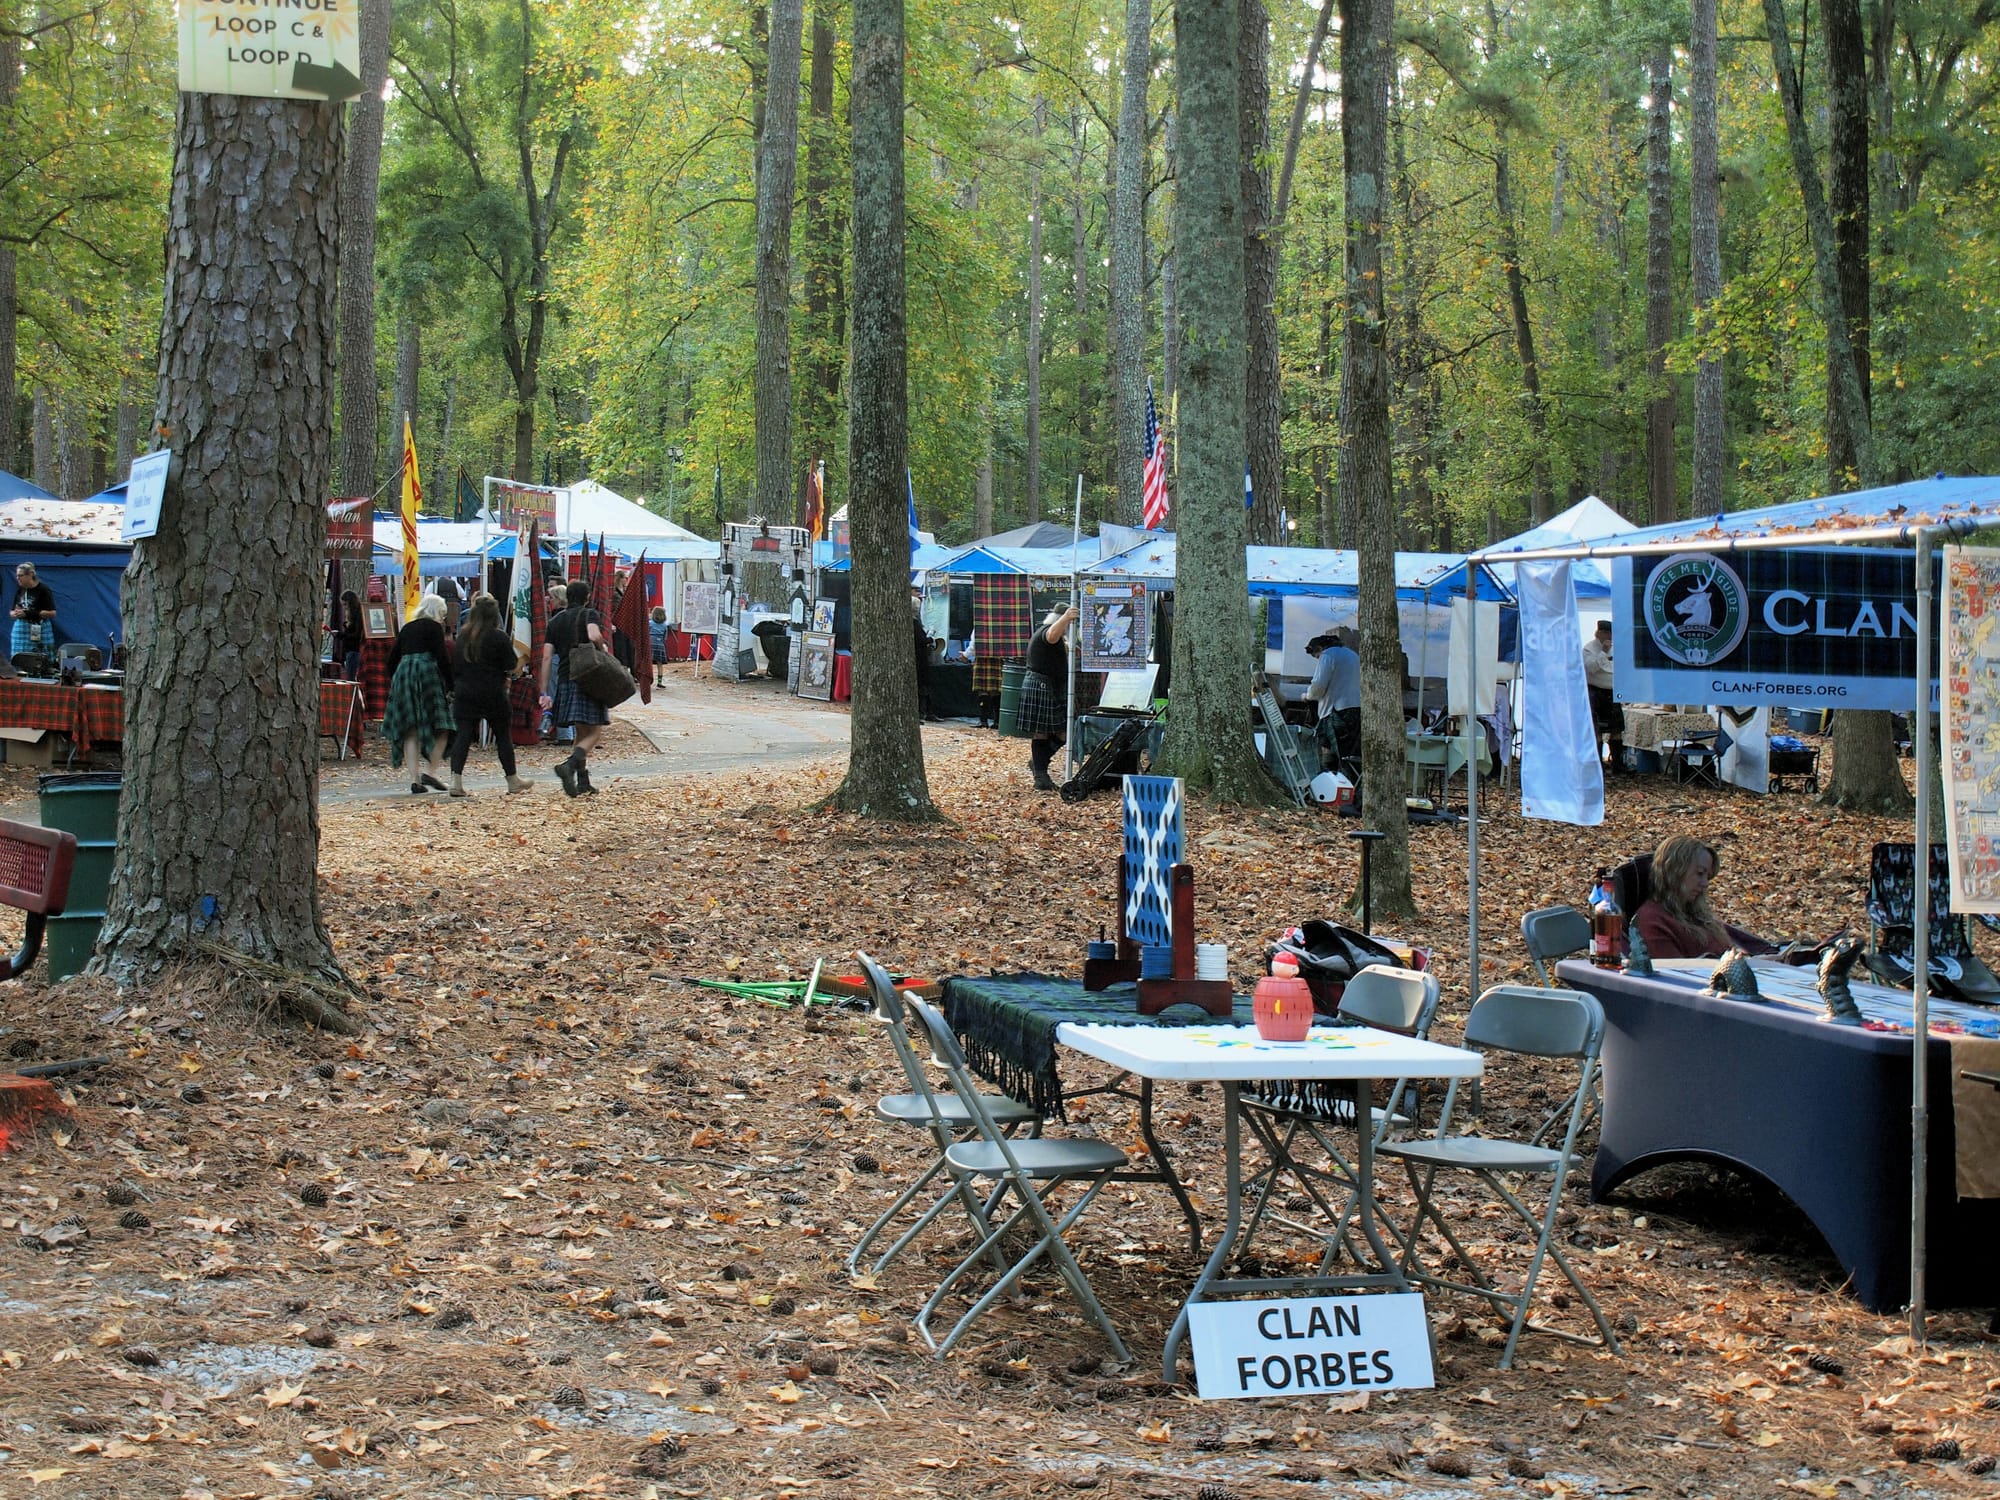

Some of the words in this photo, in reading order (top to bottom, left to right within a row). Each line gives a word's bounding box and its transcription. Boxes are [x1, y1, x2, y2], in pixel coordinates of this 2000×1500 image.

[215, 16, 277, 34] LOOP
[291, 22, 304, 36] C
[312, 26, 323, 38] &
[228, 47, 289, 65] LOOP
[1653, 570, 1677, 612] GRACE
[1681, 563, 1698, 574] ME
[1718, 575, 1738, 613] GUIDE
[1257, 1304, 1361, 1340] CLAN
[1237, 1350, 1394, 1390] FORBES
